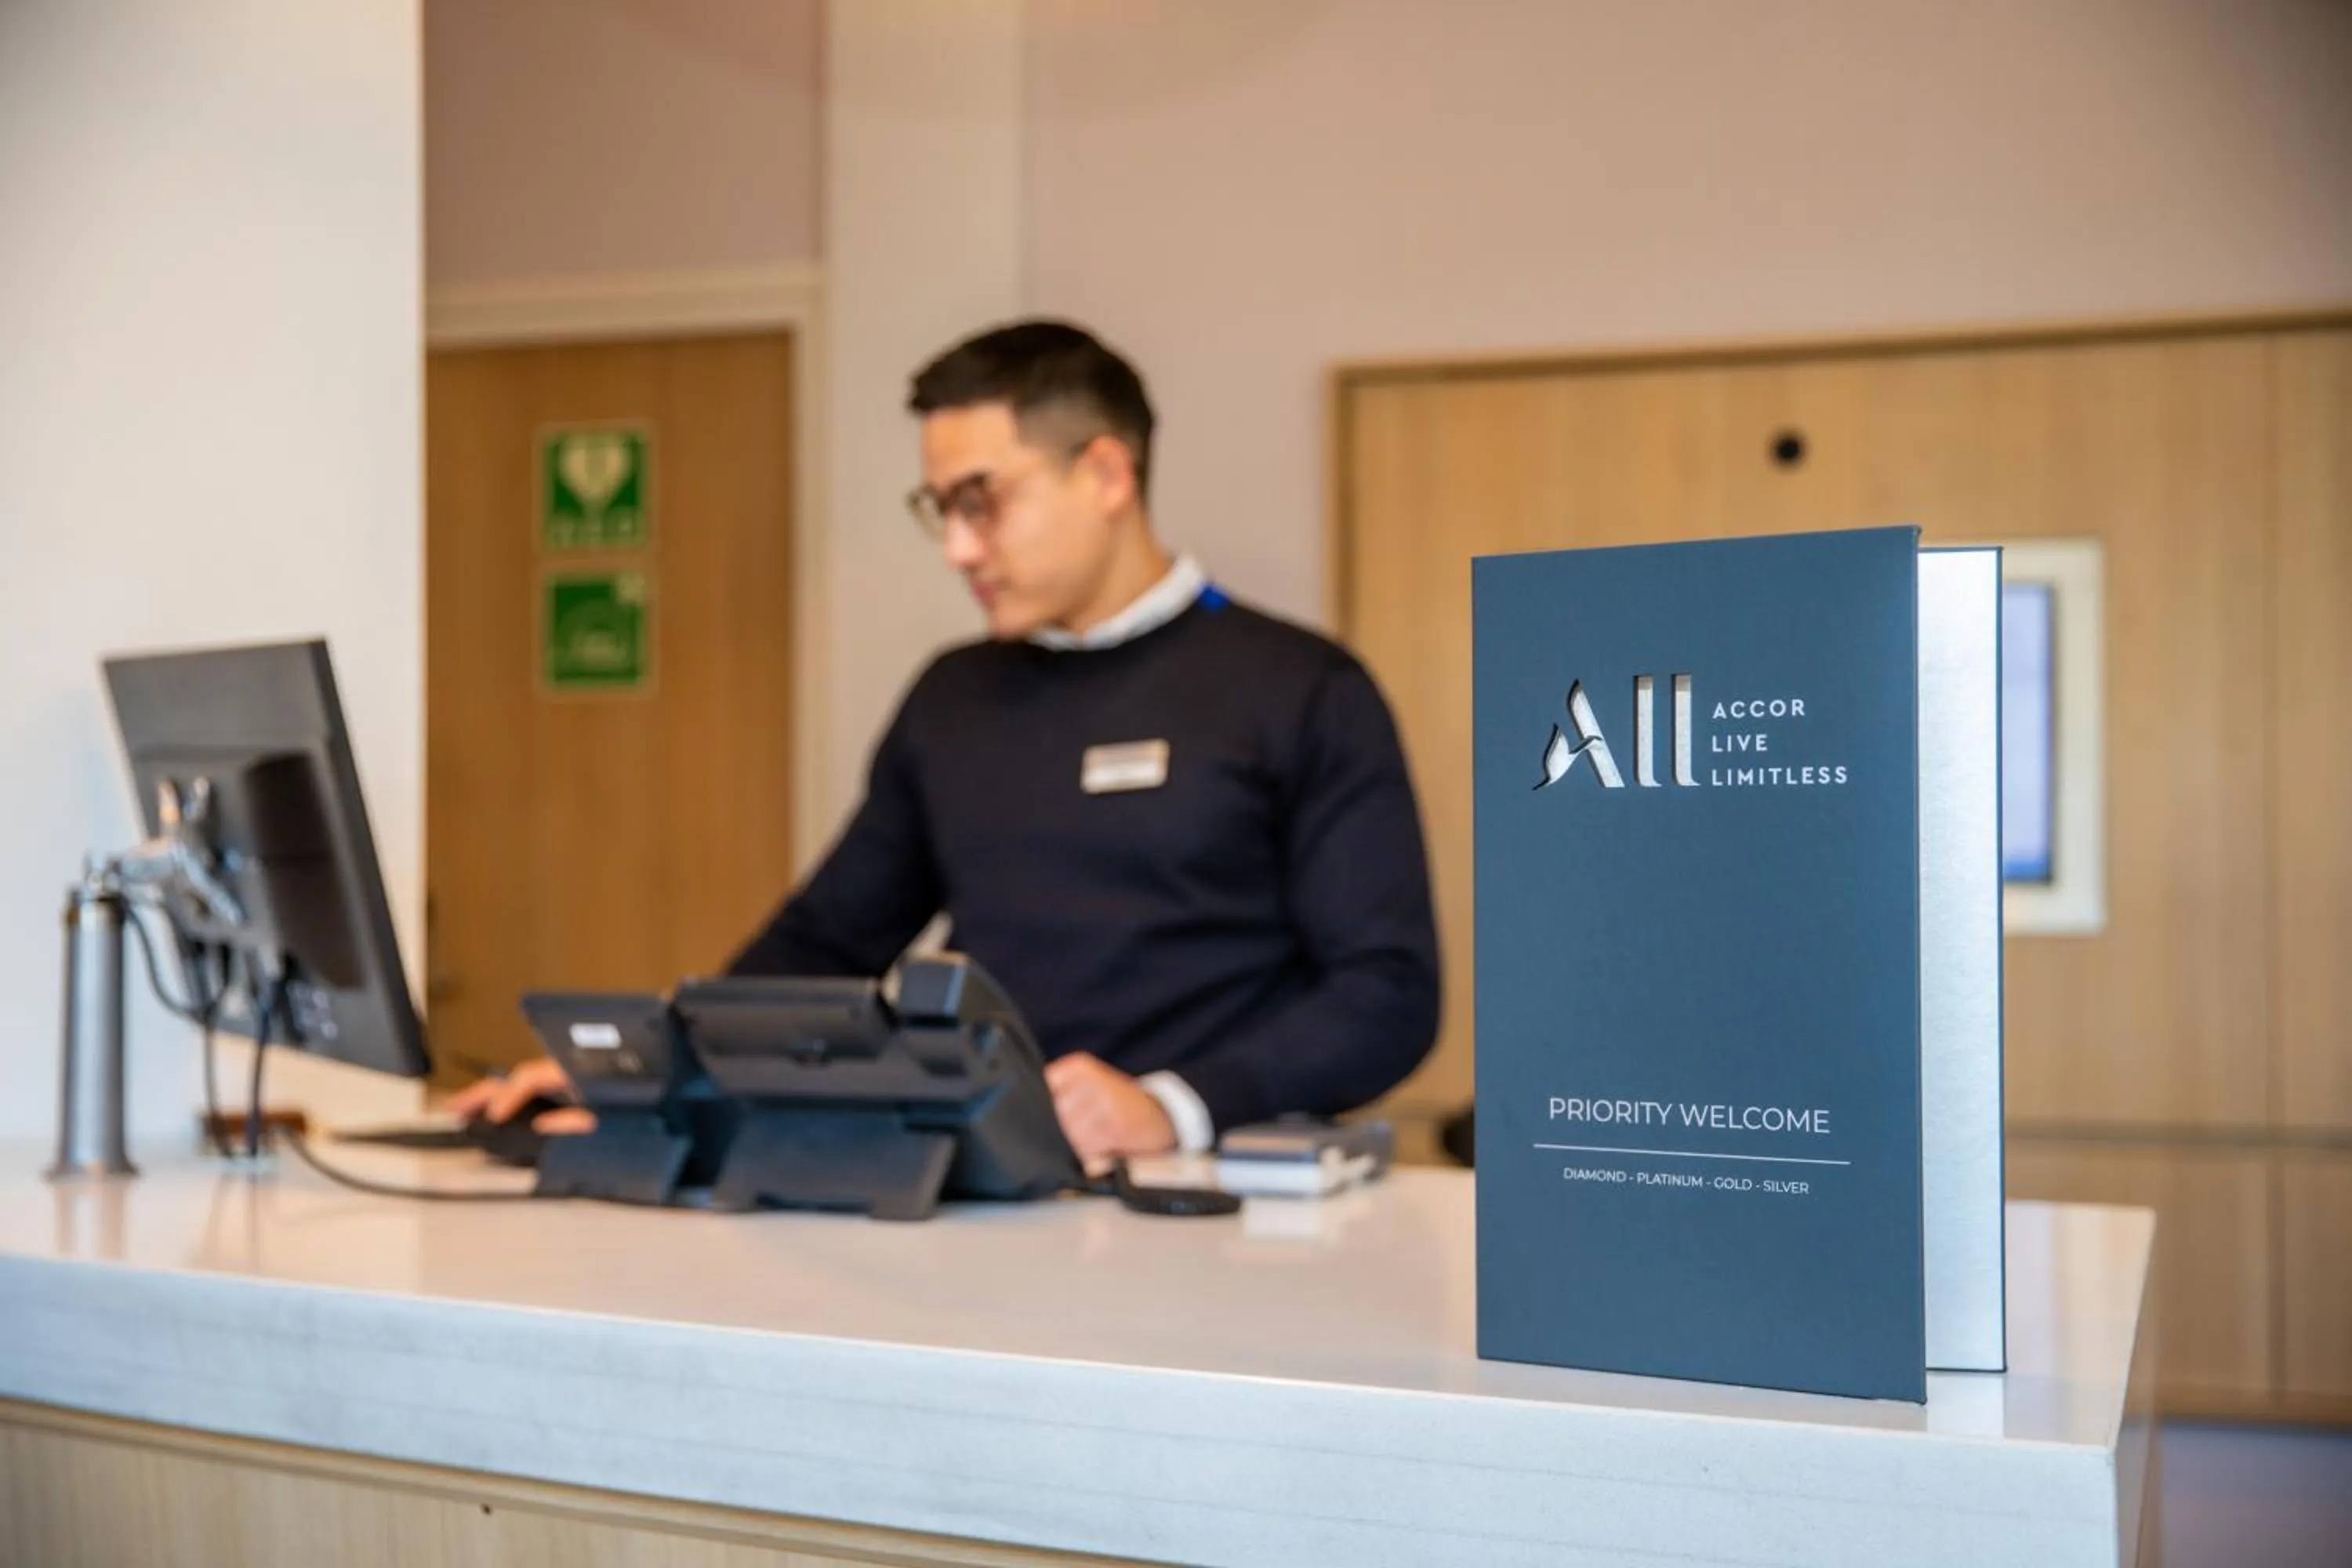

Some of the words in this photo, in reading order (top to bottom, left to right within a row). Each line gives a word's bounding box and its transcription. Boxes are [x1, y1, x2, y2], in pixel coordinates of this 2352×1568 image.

[1711, 699, 1805, 719] ACCOR
[1711, 734, 1768, 753] LIVE
[1711, 766, 1847, 786] LIMITLESS
[1549, 1097, 1672, 1125] PRIORITY
[1679, 1103, 1830, 1134] WELCOME
[1563, 1167, 1627, 1183] DIAMOND
[1636, 1172, 1703, 1187] PLATINUM
[1714, 1176, 1753, 1191] GOLD
[1763, 1180, 1809, 1194] SILVER
